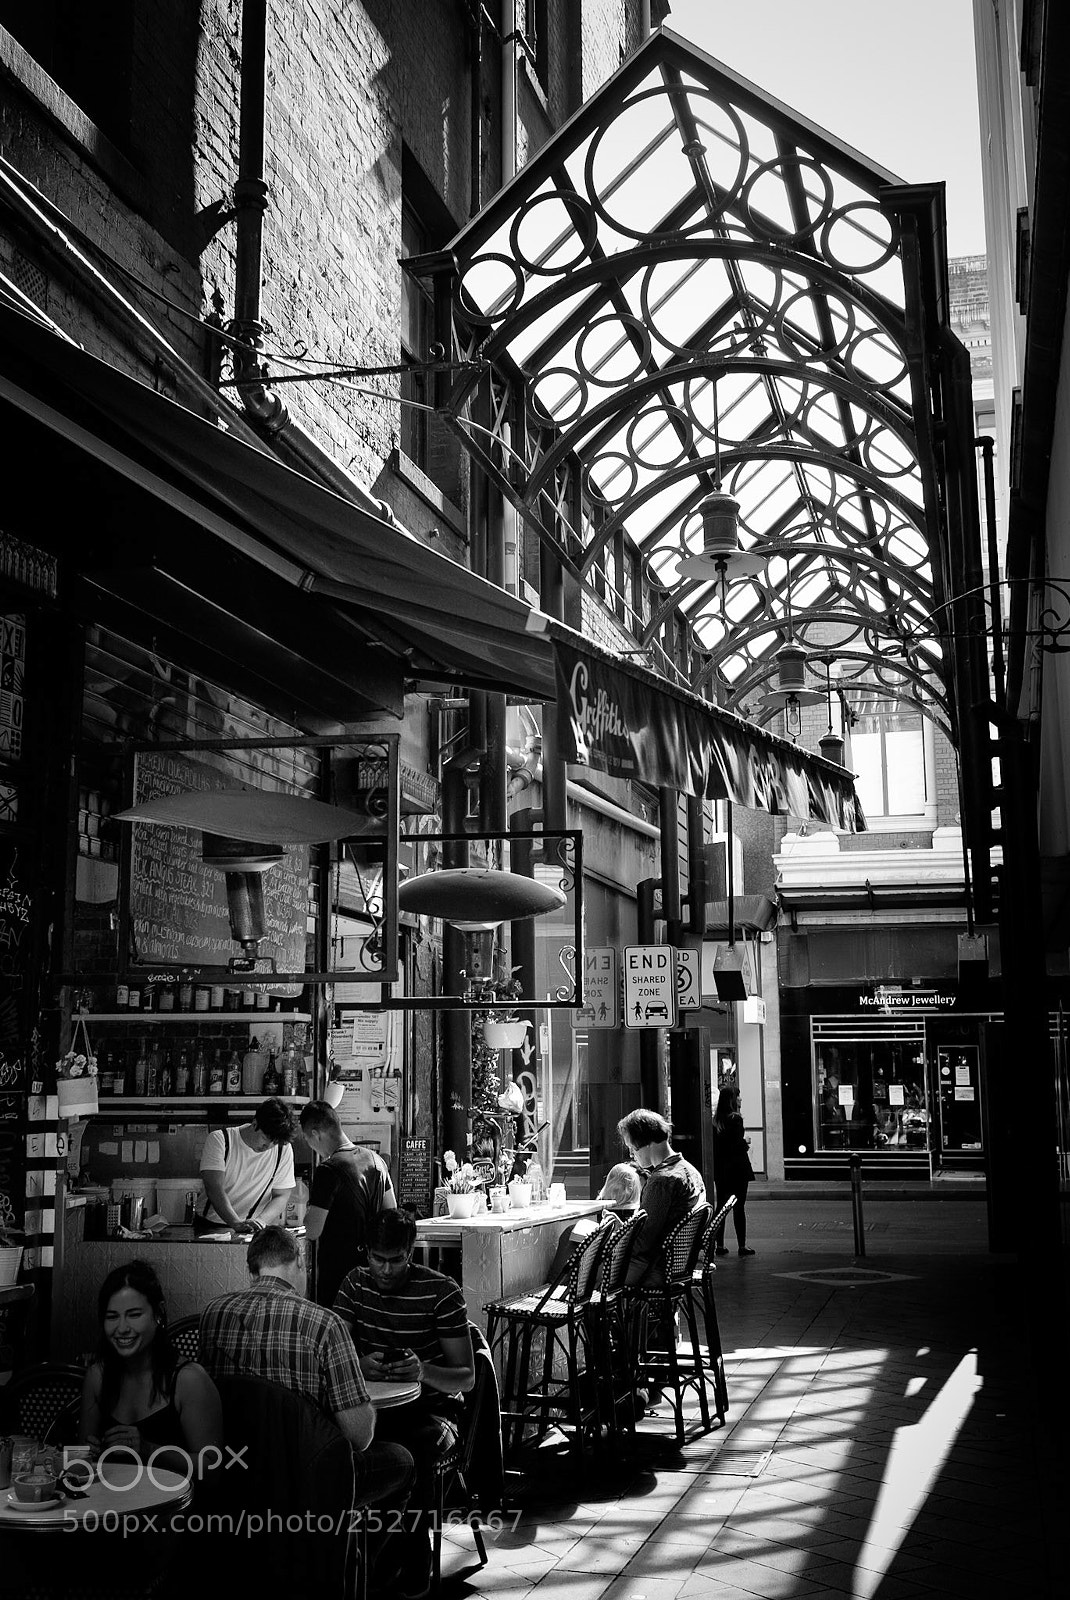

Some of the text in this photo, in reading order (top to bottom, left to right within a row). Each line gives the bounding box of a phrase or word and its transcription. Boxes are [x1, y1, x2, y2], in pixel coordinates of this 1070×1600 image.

[629, 954, 667, 969] END
[632, 975, 666, 984] SHARED
[638, 988, 660, 996] ZONE
[859, 994, 956, 1007] McAndrew Jewellery
